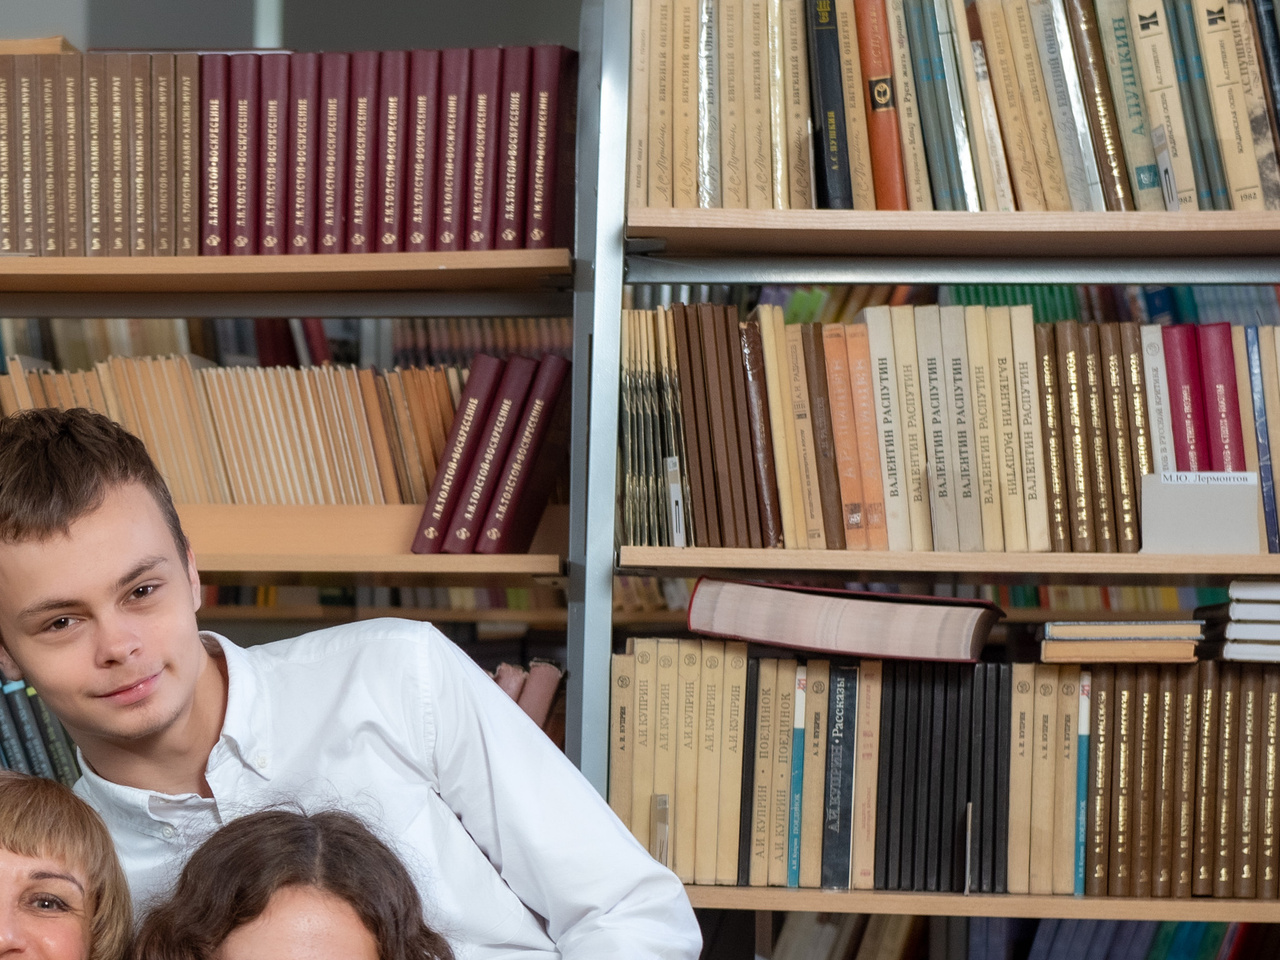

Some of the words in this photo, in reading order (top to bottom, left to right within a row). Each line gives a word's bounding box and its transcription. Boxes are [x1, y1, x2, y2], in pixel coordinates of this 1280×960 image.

[659, 4, 667, 46] ОНЕГИН
[682, 6, 690, 48] ОНЕГИН
[725, 5, 734, 47] ОНЕГИН
[788, 7, 798, 51] ОНЕГИН
[839, 10, 851, 54] ОНЕГИН
[1014, 5, 1030, 49] ОНЕГИН
[658, 51, 666, 101] ЕВГЕНИЙ
[681, 53, 689, 102] ЕВГЕНИЙ
[725, 52, 735, 101] ЕВГЕНИЙ
[790, 54, 800, 104] ЕВГЕНИЙ
[843, 57, 856, 108] ЕВГЕНИЙ
[902, 80, 912, 103] Руси
[1022, 51, 1041, 103] ЕВГЕНИЙ
[1110, 15, 1146, 137] А.ПУШКИН
[209, 98, 219, 162] ВОСКРЕСЕНИЕ
[296, 98, 307, 162] ВОСКРЕСЕНИЕ
[386, 96, 398, 160] ВОСКРЕСЕНИЕ
[475, 93, 488, 156] ВОСКРЕСЕНИЕ
[535, 91, 548, 155] ВОСКРЕСЕНИЕ
[877, 356, 892, 424] РАСПУТИН
[902, 363, 916, 428] РАСПУТИН
[926, 356, 941, 424] РАСПУТИН
[951, 357, 965, 424] РАСПУТИН
[974, 365, 987, 429] РАСПУТИН
[997, 357, 1011, 427] ВАЛЕНТИН
[1018, 361, 1032, 426] РАСПУТИН
[1042, 353, 1053, 386] ПРОЗА
[1066, 351, 1077, 384] ПРОЗА
[1108, 354, 1119, 386] ПРОЗА
[1129, 352, 1140, 385] ПРОЗА
[1151, 365, 1162, 405] КРИТИКЕ
[449, 396, 480, 459] ВОСКРЕСЕНИЕ
[481, 397, 514, 460] ВОСКРЕСЕНИЕ
[514, 398, 545, 461] ВОСКРЕСЕНИЕ
[883, 429, 898, 496] ВАЛЕНТИН
[908, 432, 922, 502] ВАЛЕНТИН
[932, 429, 947, 497] ВАЛЕНТИН
[957, 430, 971, 498] ВАЛЕНТИН
[979, 435, 993, 504] ВАЛЕНТИН
[1003, 431, 1017, 496] РАСПУТИН
[1023, 430, 1037, 500] ВАЛЕНТИН
[1049, 436, 1062, 495] ЛЕРМОНТОВ
[1072, 433, 1085, 492] ЛЕРМОНТОВ
[1115, 436, 1129, 495] ЛЕРМОНТОВ
[1192, 474, 1249, 487] Лермонтов
[638, 679, 648, 726] КУПРИН
[660, 683, 669, 729] КУПРИН
[684, 681, 694, 727] КУПРИН
[729, 684, 740, 731] КУПРИН
[759, 686, 772, 759] ПОЕДИНОК
[778, 690, 791, 763] ПОЕДИНОК
[832, 676, 845, 737] Рассказы
[829, 743, 842, 806] КУПРИН
[756, 784, 767, 832] КУПРИН
[775, 788, 786, 836] КУПРИН
